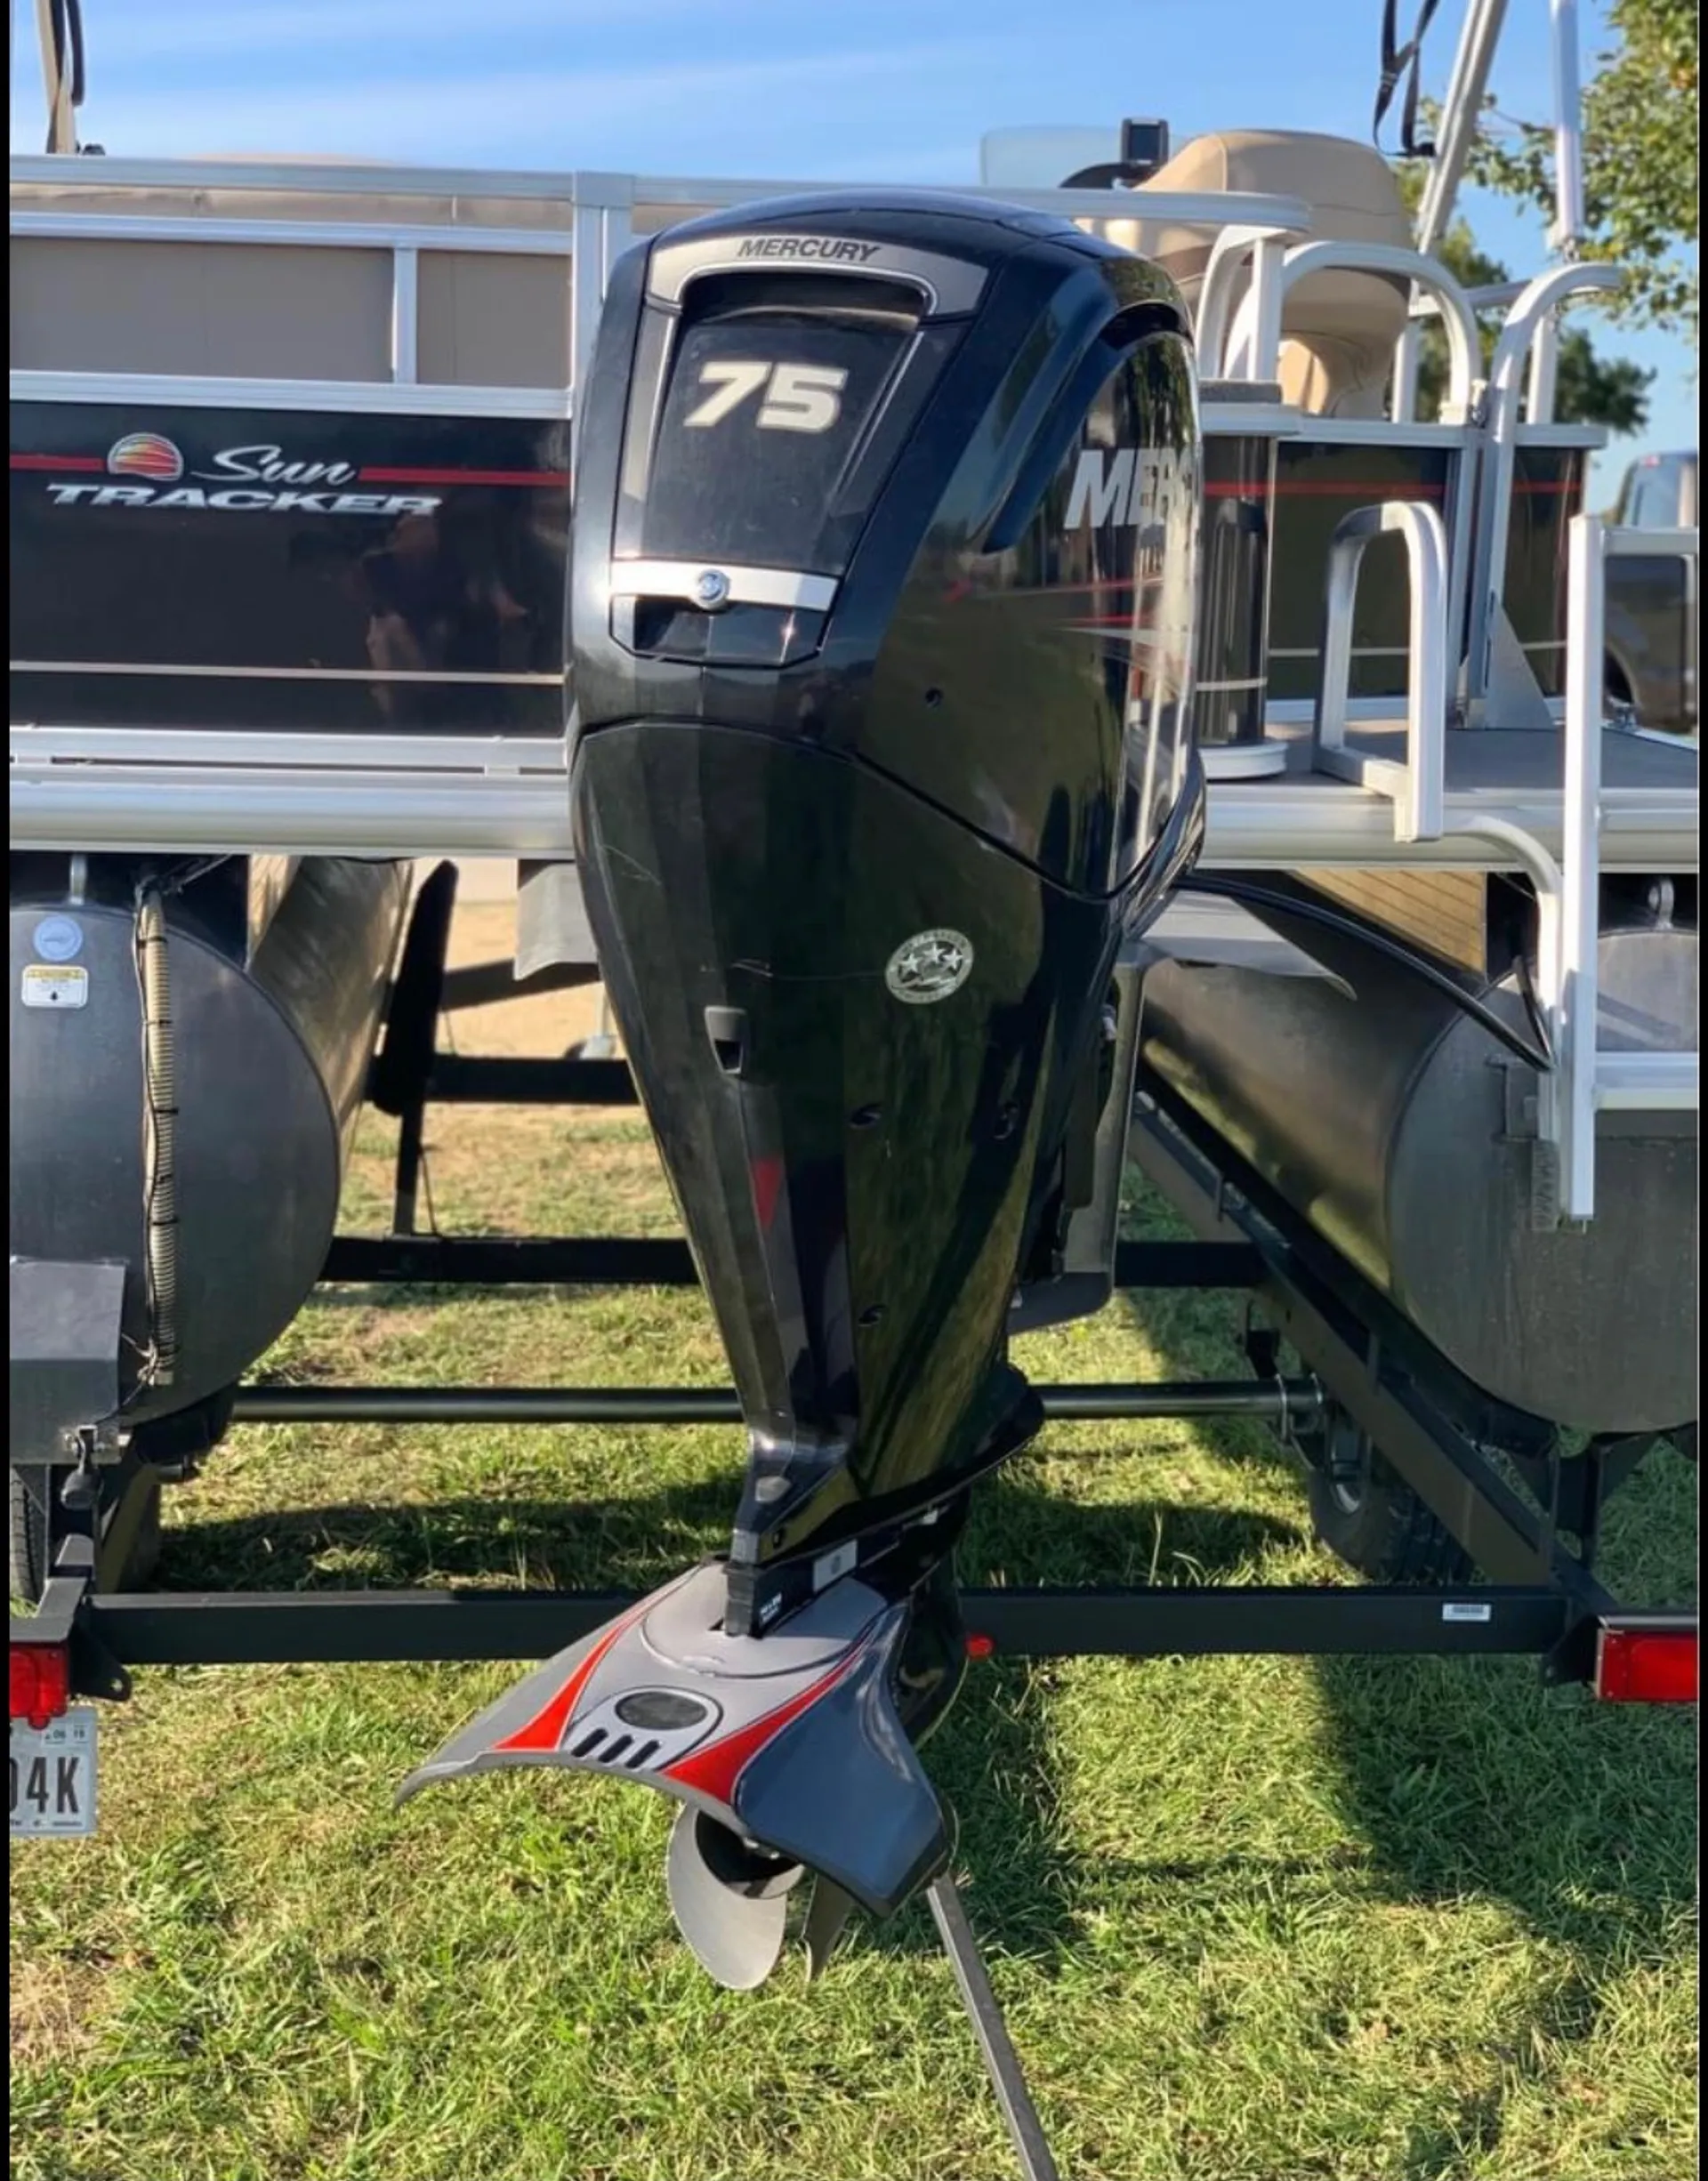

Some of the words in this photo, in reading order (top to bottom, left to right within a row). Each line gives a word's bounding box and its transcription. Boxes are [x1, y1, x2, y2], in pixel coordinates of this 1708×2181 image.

[737, 238, 882, 261] MERCURY
[683, 361, 849, 434] 75
[190, 445, 357, 487] Sun
[46, 483, 443, 517] TRACKER
